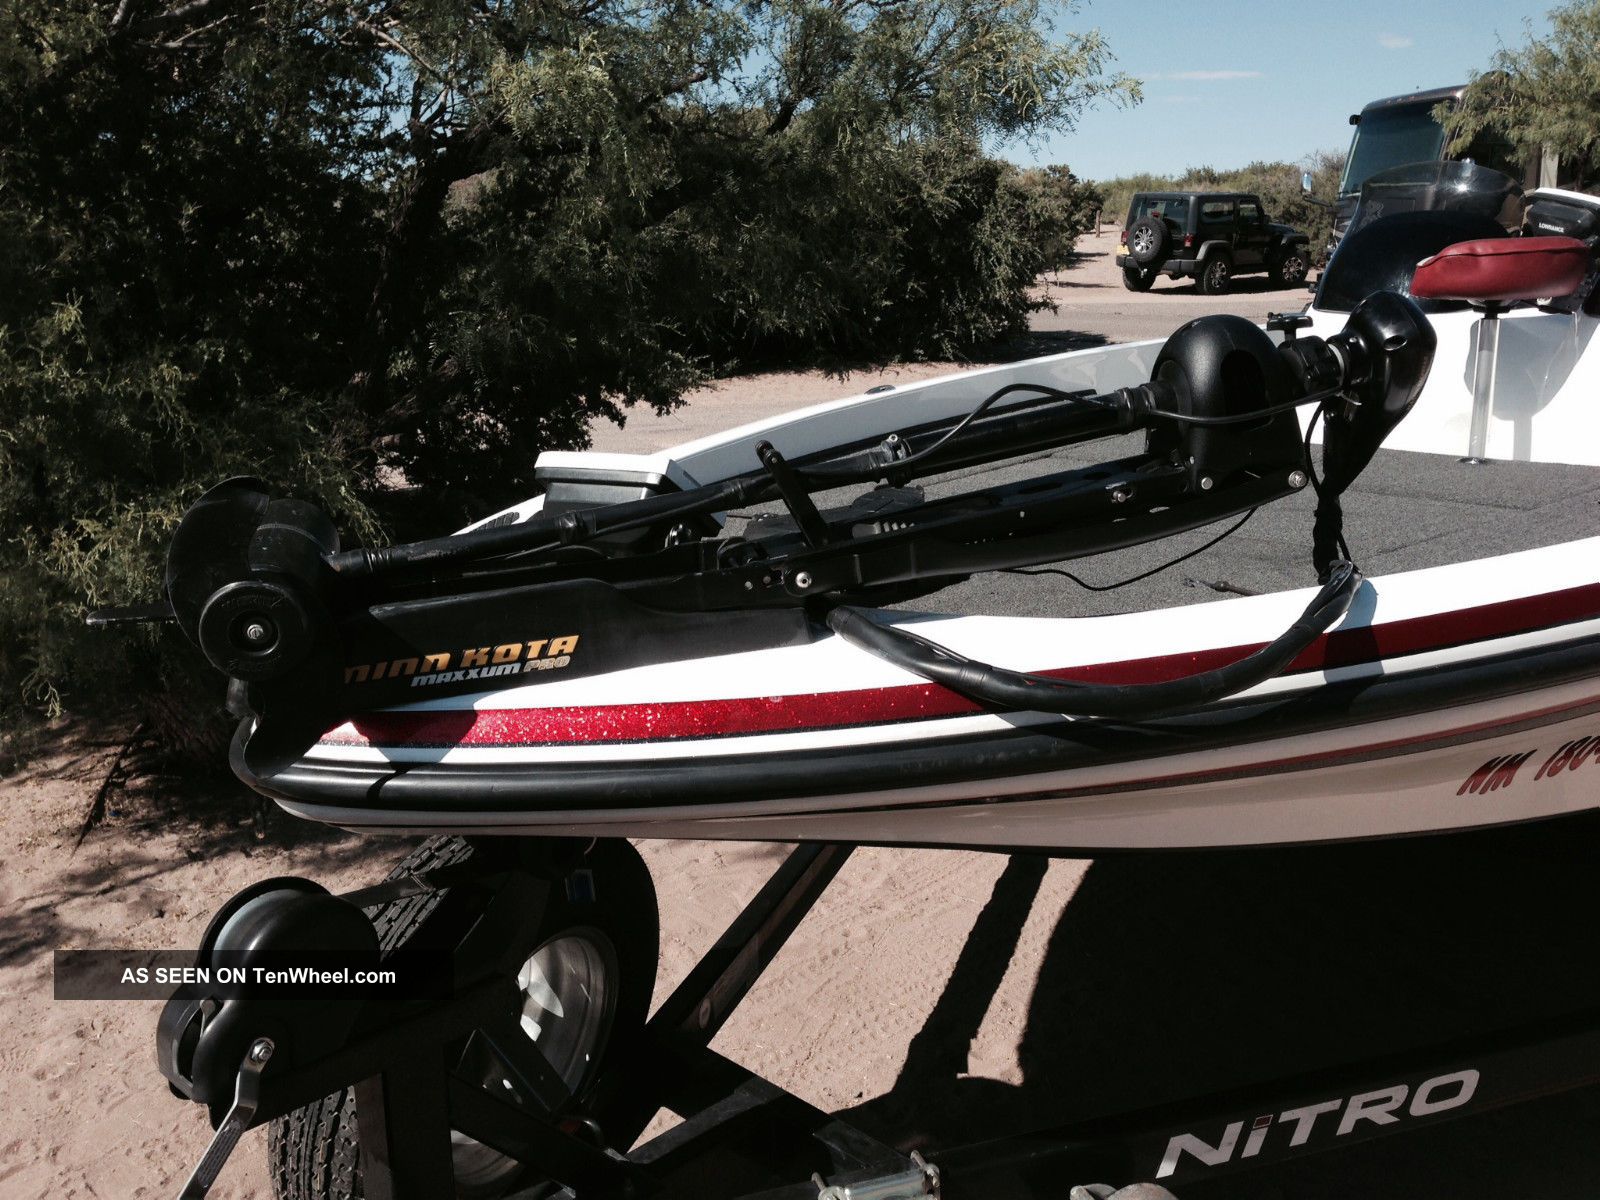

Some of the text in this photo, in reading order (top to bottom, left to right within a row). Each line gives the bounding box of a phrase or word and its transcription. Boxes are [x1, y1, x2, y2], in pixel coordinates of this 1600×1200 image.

[461, 634, 579, 667] KOTA
[410, 655, 572, 688] MAXXUM PRO
[1456, 749, 1538, 796] NM
